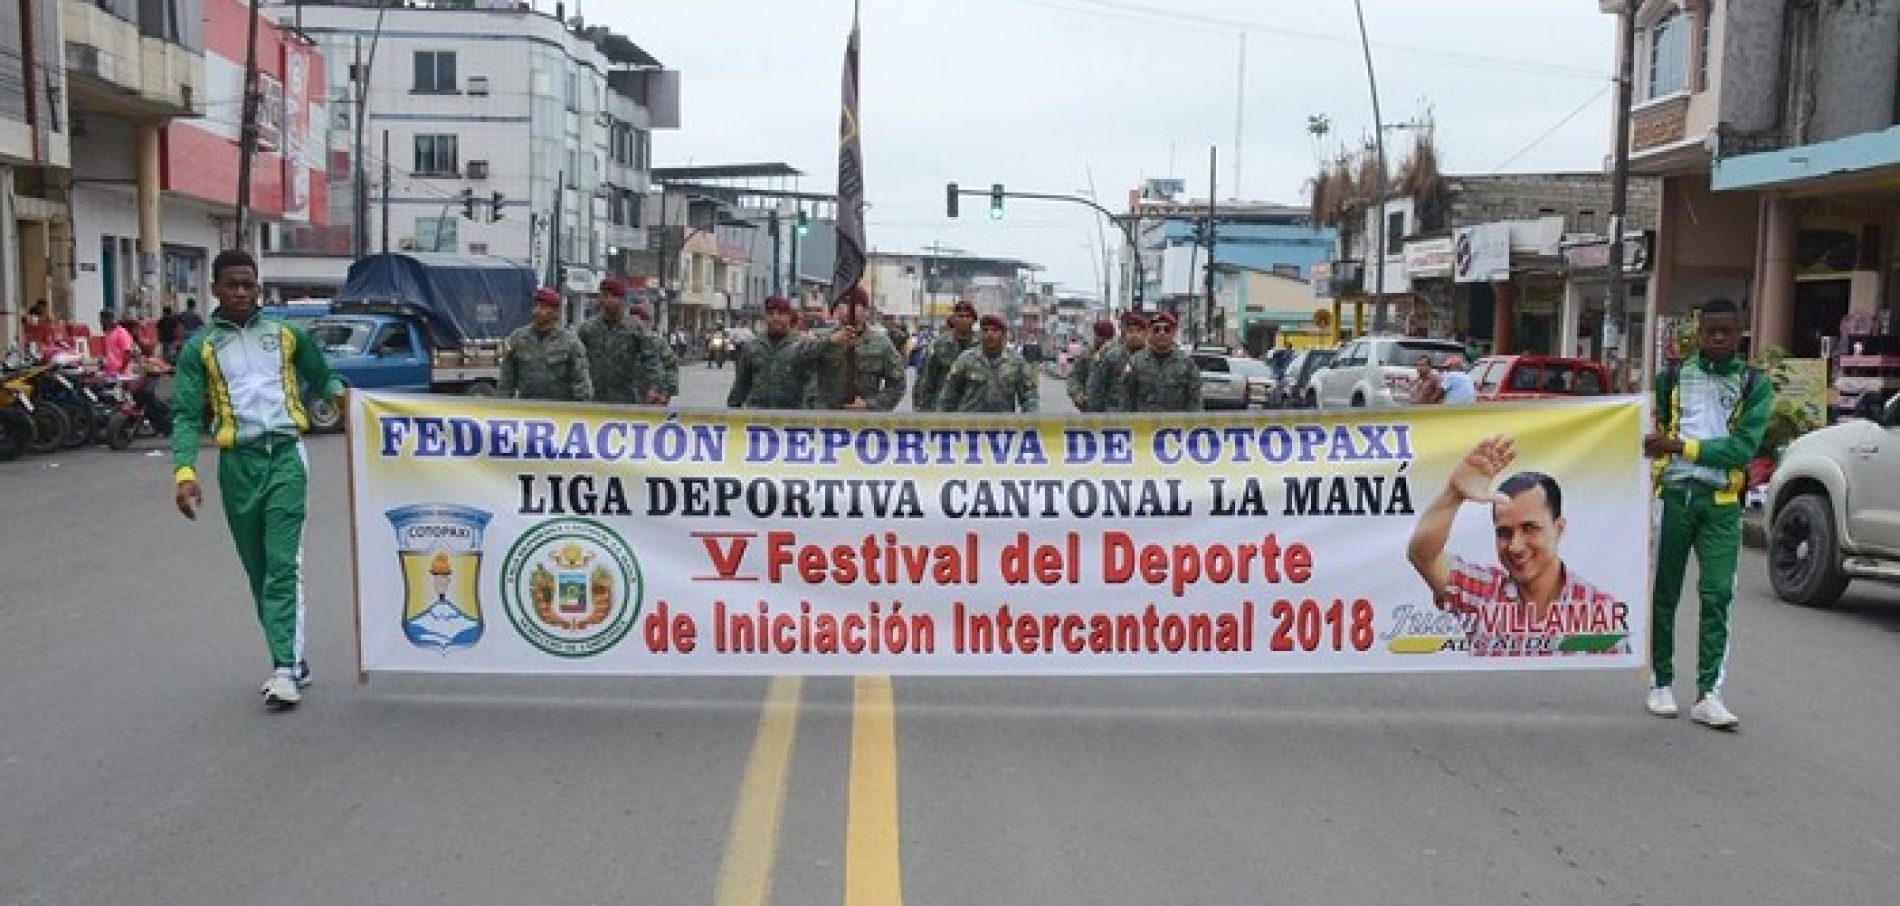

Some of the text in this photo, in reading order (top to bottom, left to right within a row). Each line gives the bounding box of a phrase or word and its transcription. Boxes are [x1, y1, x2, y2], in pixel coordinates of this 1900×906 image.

[381, 412, 1412, 464] FEDERACIÓN DEPORTIVA DE COTOPAXI
[519, 461, 1414, 518] LIGA DEPORTIVA CANTONAL LA MANÁ
[694, 531, 757, 581] V
[768, 532, 980, 584] Festival
[1001, 532, 1079, 584] del
[1102, 532, 1312, 596] Deporte
[644, 602, 697, 654] de
[715, 601, 936, 654] Iniciación
[954, 602, 1254, 654] Intercantonal
[1271, 600, 1373, 653] 2018
[1480, 603, 1629, 633] VILLAMAR
